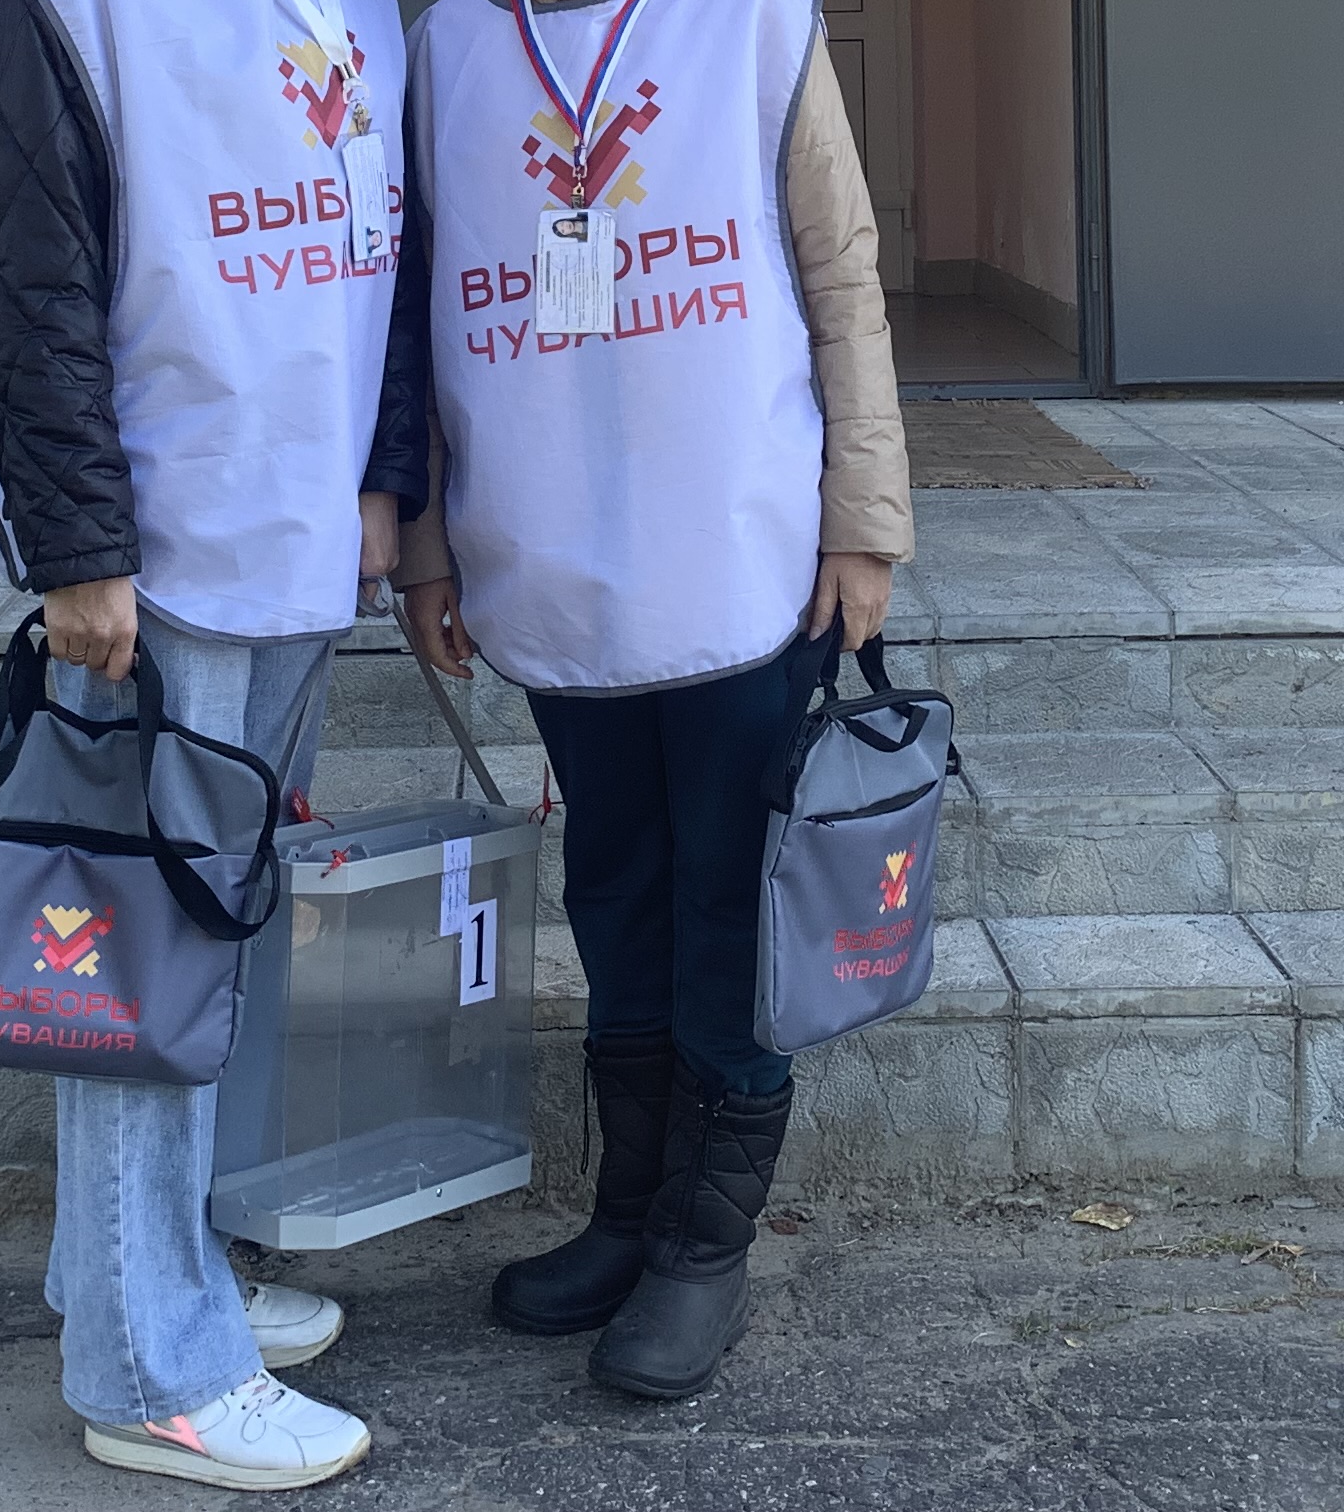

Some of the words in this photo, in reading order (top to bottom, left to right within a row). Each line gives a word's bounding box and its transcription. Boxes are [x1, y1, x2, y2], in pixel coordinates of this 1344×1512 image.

[208, 178, 403, 238] ВЫБР
[460, 219, 741, 312] ВЫОРЫ
[469, 909, 488, 989] 1
[832, 945, 910, 984] ЧУВАШИ
